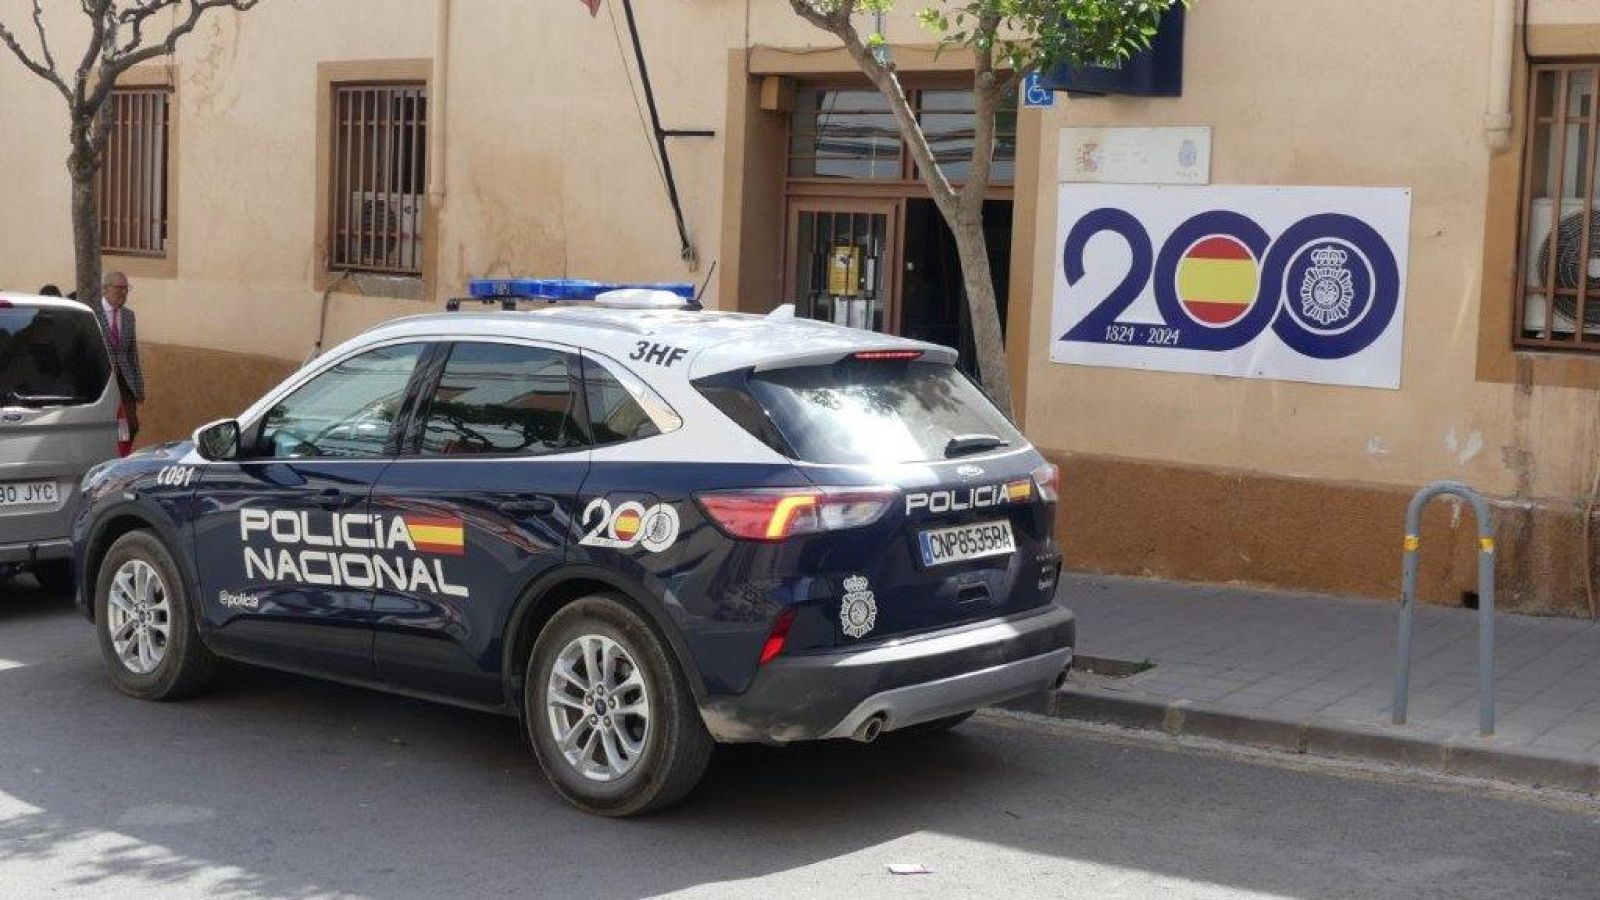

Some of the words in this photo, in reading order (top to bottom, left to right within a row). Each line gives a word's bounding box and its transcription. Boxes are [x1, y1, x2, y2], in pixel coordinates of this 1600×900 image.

[1059, 207, 1399, 360] 200
[1105, 325, 1135, 342] 1824
[1147, 327, 1181, 345] 2024
[629, 341, 689, 367] 3HF
[25, 484, 53, 501] JYC
[578, 498, 680, 553] 200
[929, 524, 1012, 559] CNP8535BA
[243, 547, 469, 597] NACIONAL
